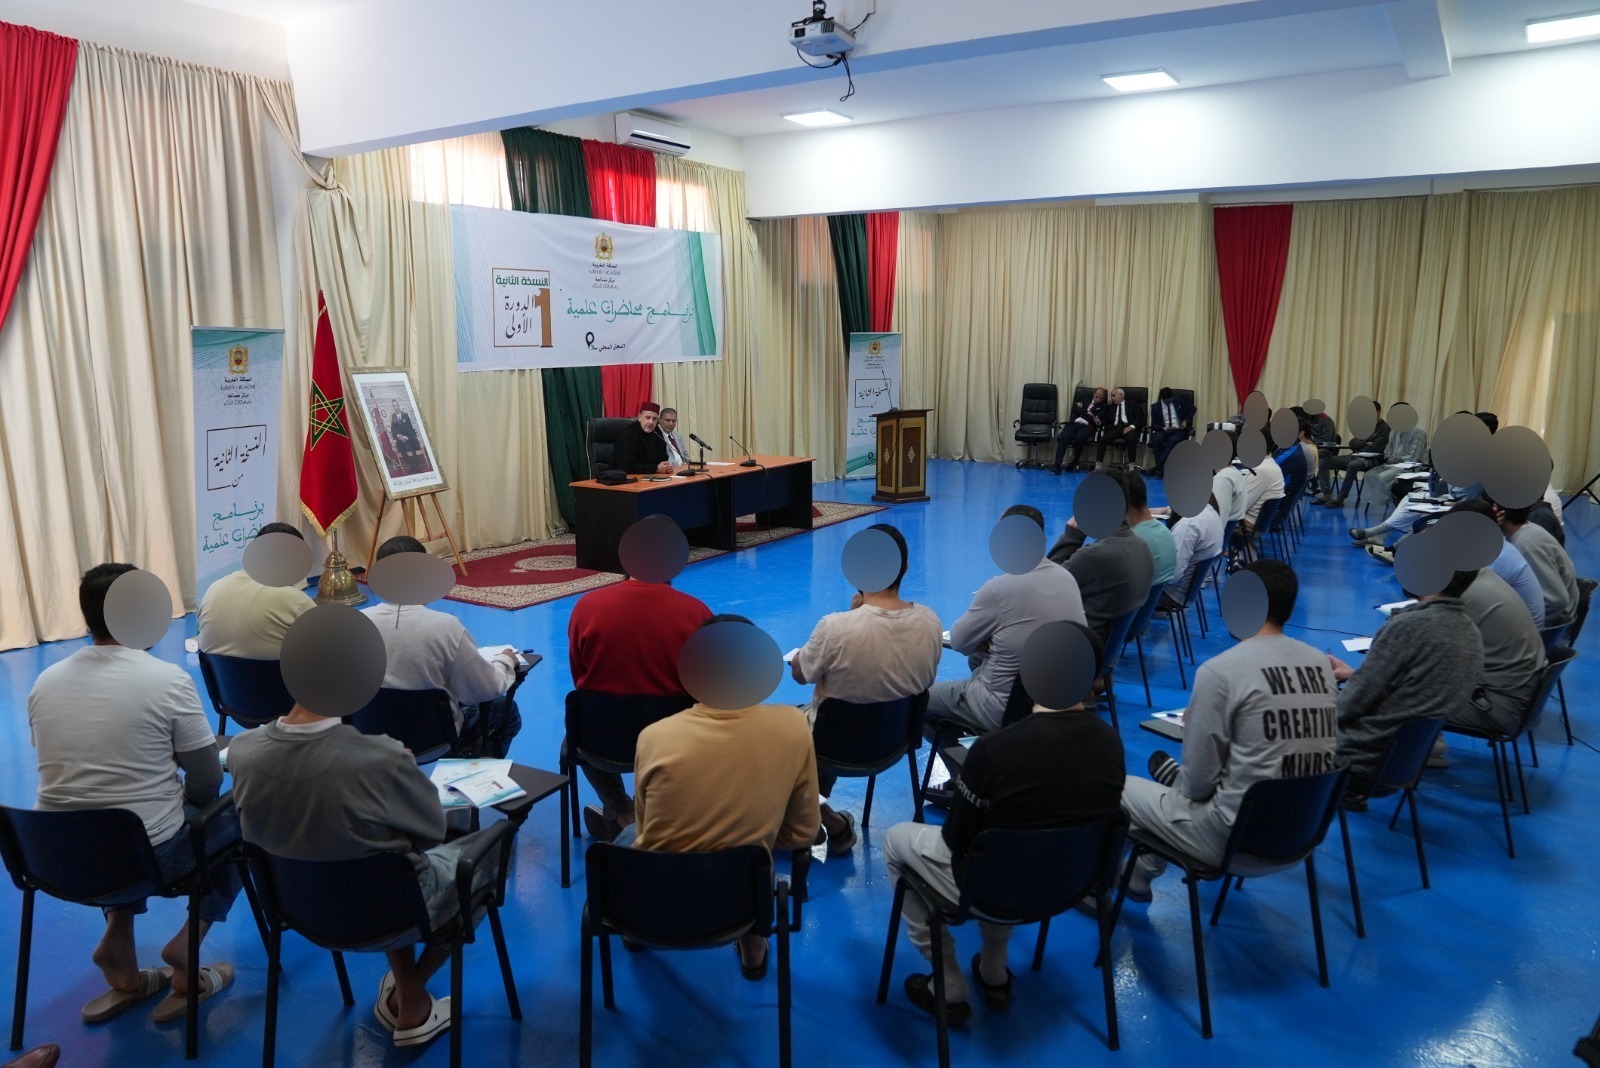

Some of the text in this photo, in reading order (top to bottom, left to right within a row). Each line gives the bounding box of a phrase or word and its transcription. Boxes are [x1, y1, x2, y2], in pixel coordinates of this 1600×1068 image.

[495, 275, 549, 288] النسخة الثانية
[504, 294, 536, 312] الدورة
[566, 298, 695, 325] برنامج محاضرات علمية
[505, 313, 532, 339] الأولى
[213, 432, 265, 472] النسخة الثانية
[232, 474, 244, 487] من
[212, 500, 265, 531] برنامج
[203, 533, 229, 553] علمية
[1261, 666, 1329, 695] WE ARE
[1263, 707, 1337, 741] CREATIV
